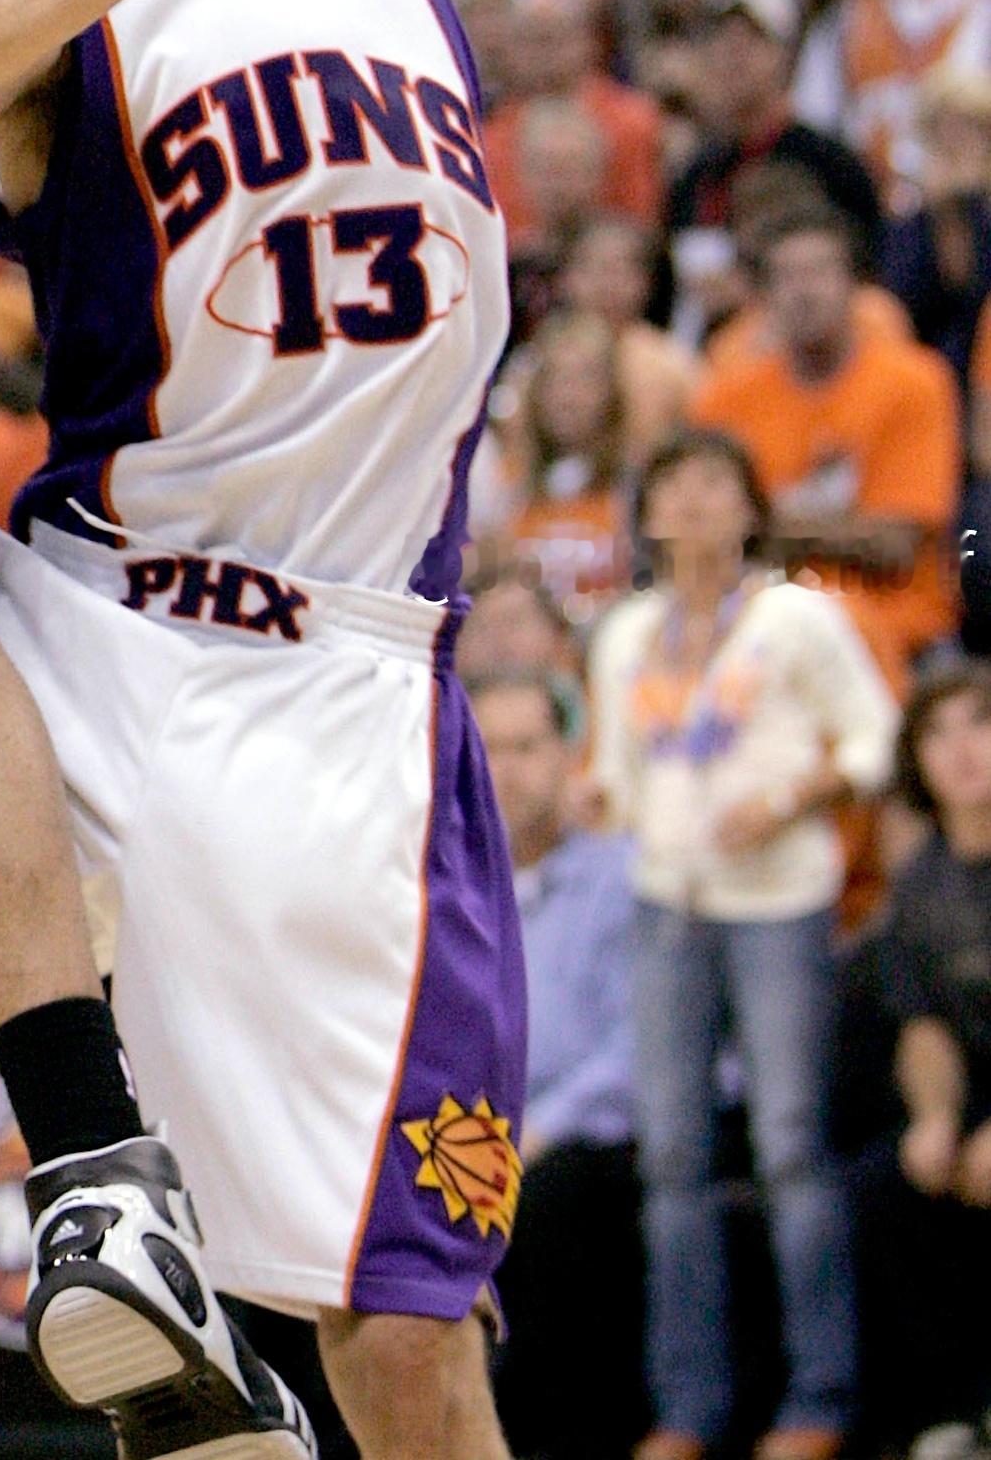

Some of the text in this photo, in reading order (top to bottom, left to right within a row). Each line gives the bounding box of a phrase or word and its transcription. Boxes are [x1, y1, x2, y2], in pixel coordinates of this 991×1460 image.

[141, 49, 496, 249] SUNS
[262, 203, 432, 357] 13
[121, 553, 308, 642] PHX
